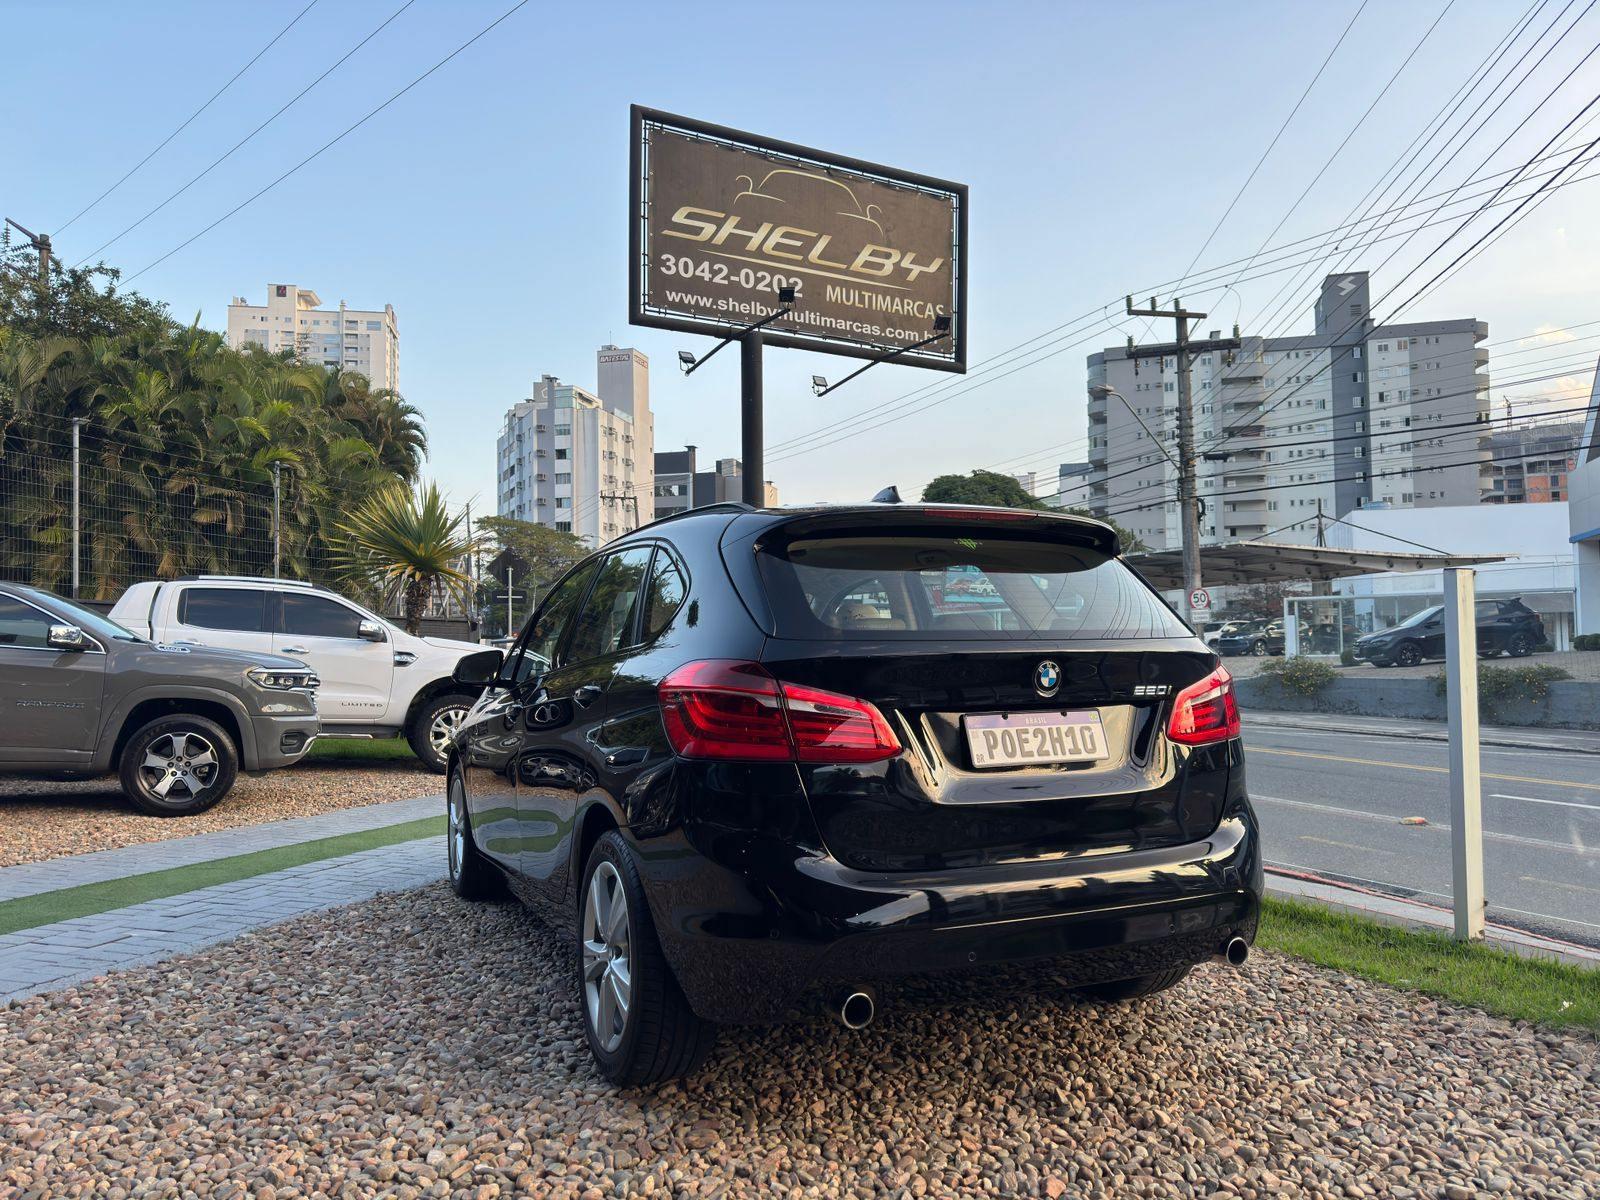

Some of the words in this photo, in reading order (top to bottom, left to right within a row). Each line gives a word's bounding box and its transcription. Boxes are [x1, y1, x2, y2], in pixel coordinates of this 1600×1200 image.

[661, 206, 944, 282] SHELBY
[660, 253, 803, 298] 3042-0202
[826, 284, 944, 320] MULTIMARCAS
[1192, 592, 1207, 604] 50
[1025, 717, 1047, 725] BRASIL
[983, 725, 1097, 760] POE2H10
